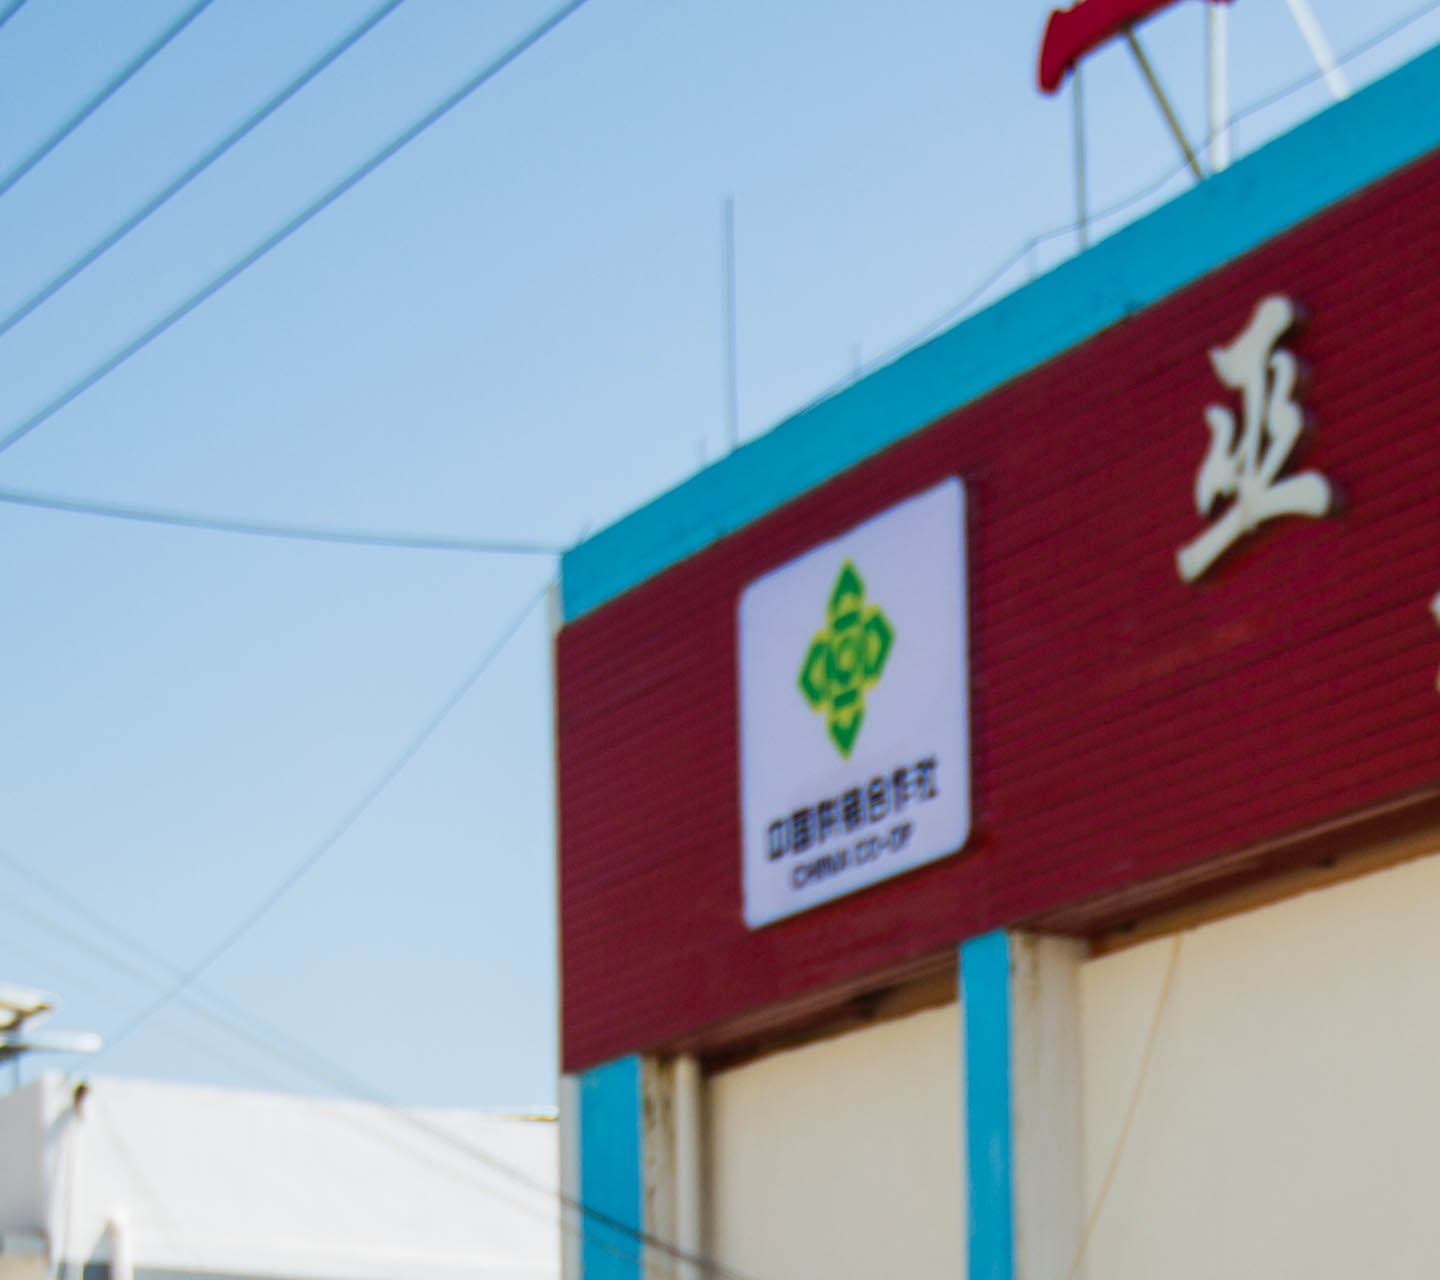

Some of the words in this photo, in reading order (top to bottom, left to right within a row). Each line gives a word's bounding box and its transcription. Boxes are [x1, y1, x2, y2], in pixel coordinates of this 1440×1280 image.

[766, 754, 940, 862] 中国供销合作社
[790, 848, 849, 890] CHINA
[852, 821, 914, 865] CO-OP
